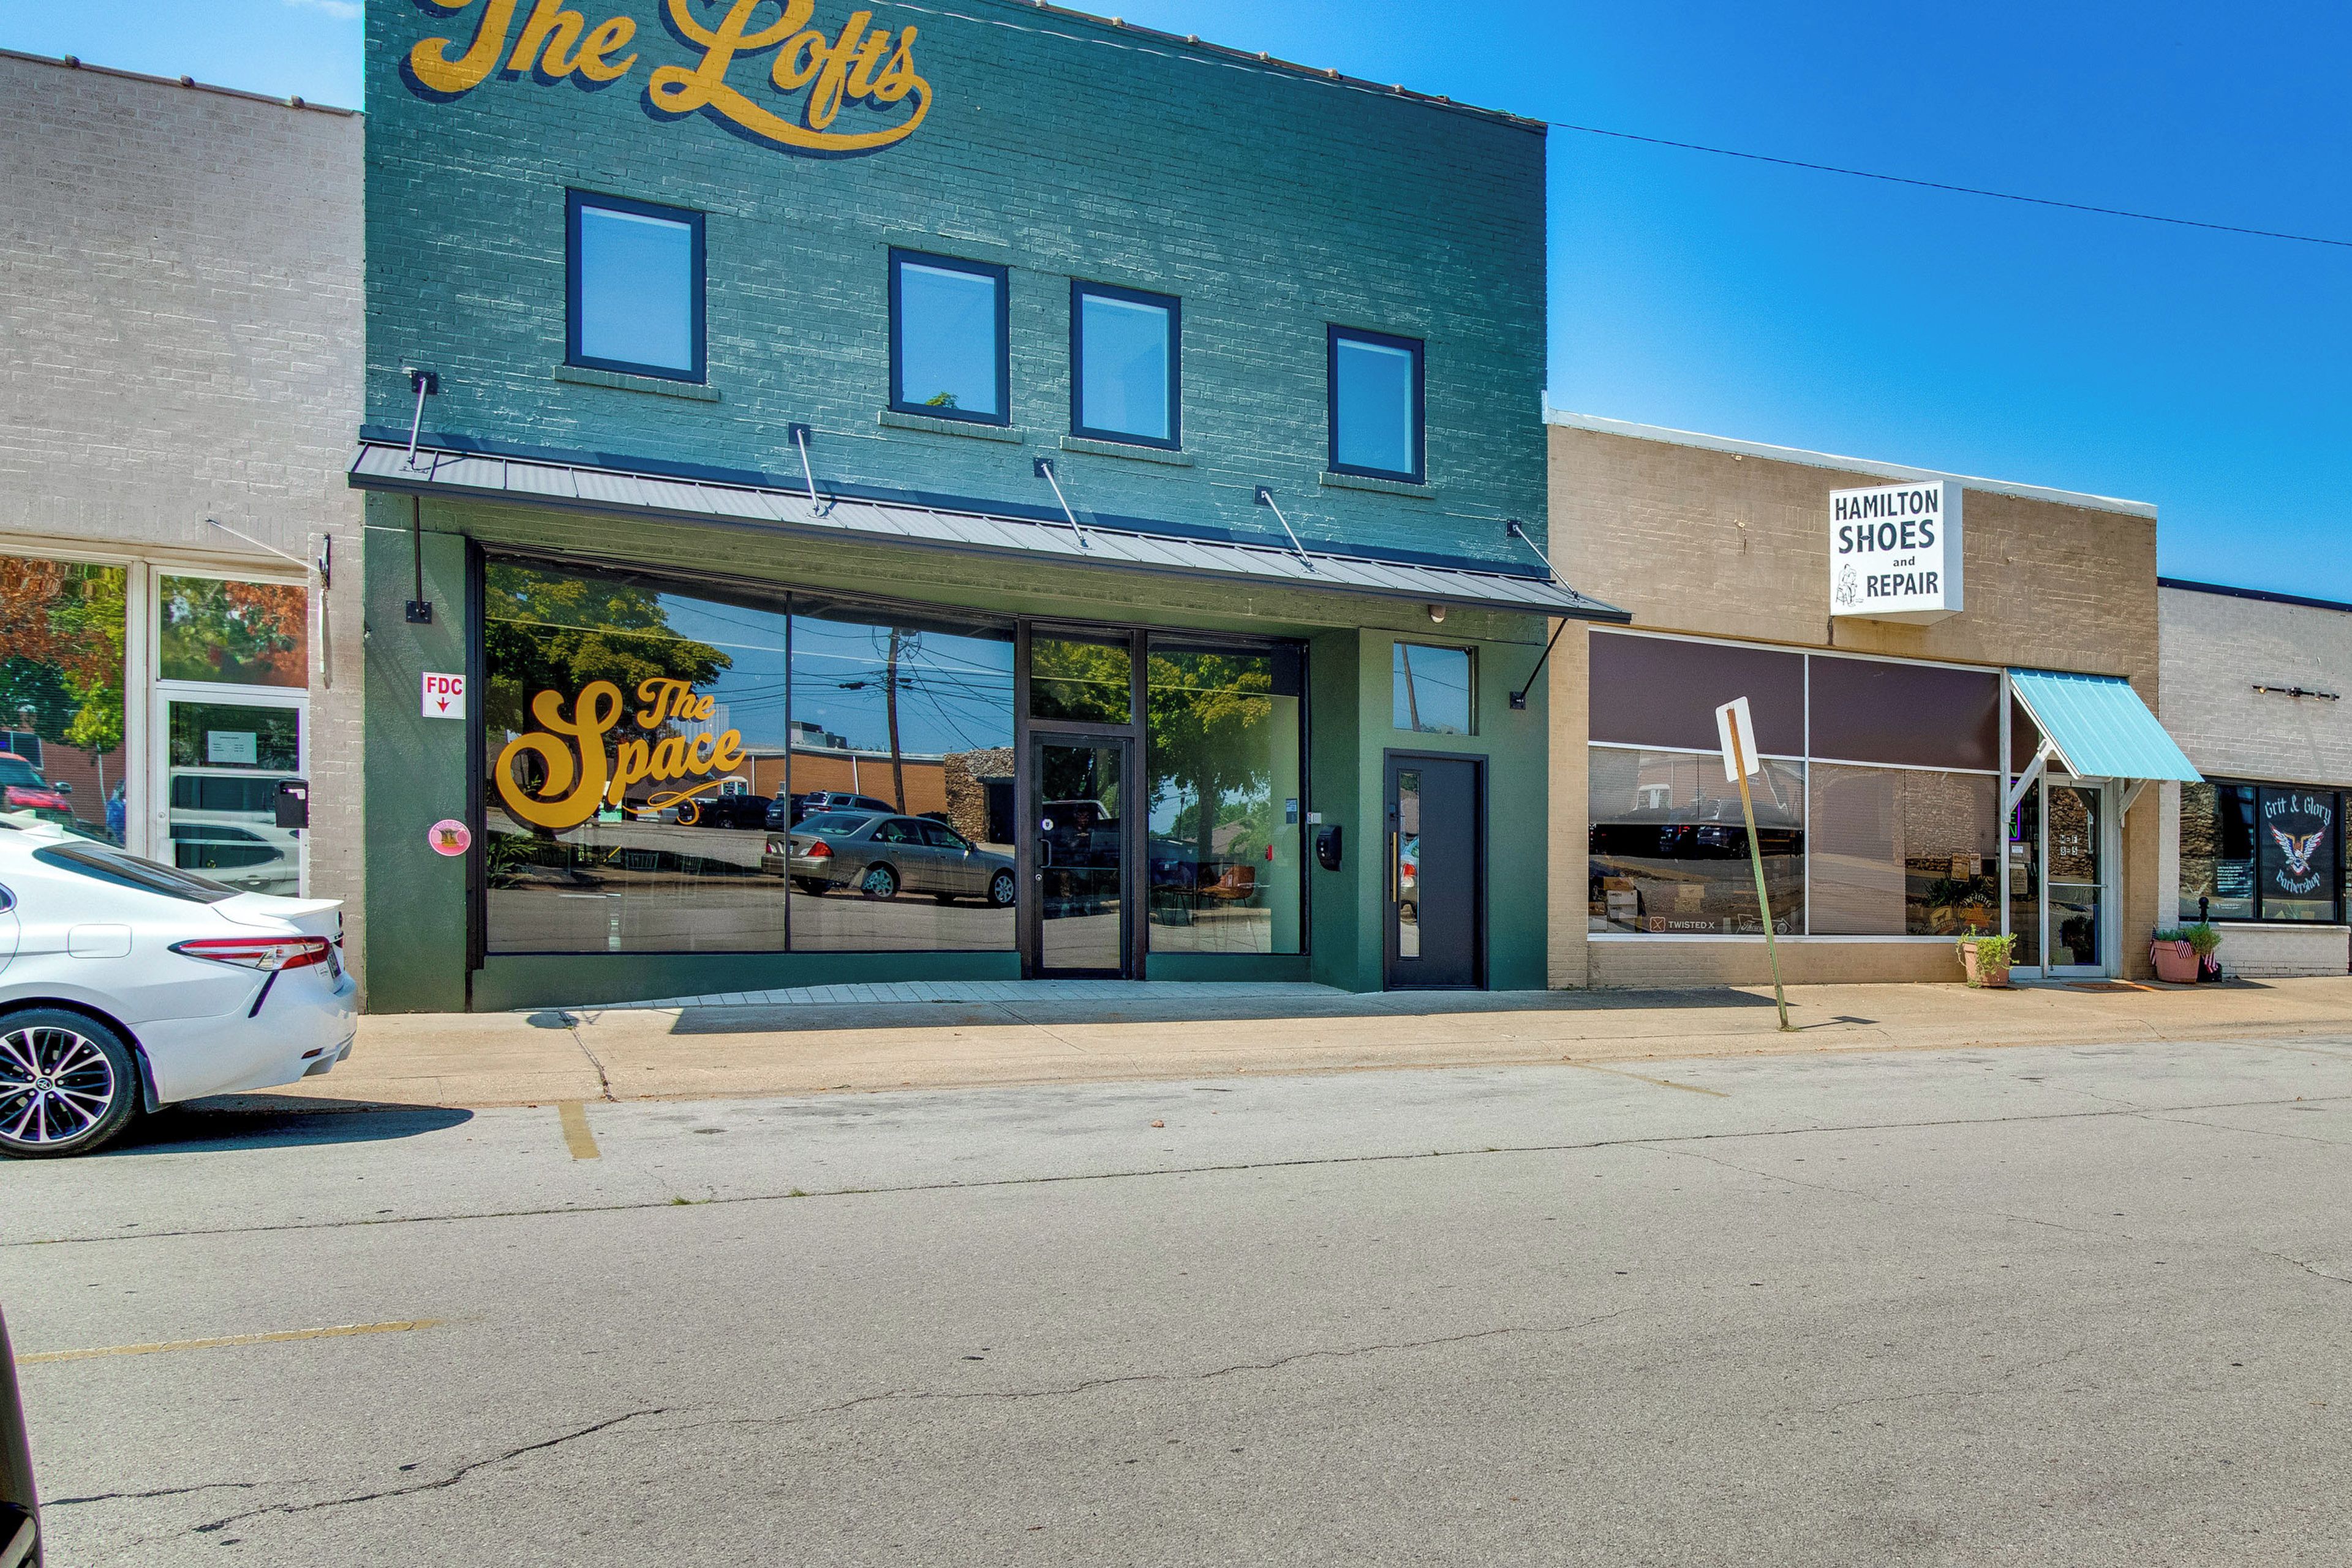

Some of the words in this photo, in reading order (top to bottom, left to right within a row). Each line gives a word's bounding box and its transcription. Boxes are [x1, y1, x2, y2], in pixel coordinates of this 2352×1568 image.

[405, 0, 638, 98] The
[647, 0, 932, 153] Lofts
[1836, 489, 1938, 521] HAMILTON
[1839, 519, 1935, 554] SHOES
[1893, 556, 1915, 567] and
[1867, 571, 1939, 598] REPAIR
[427, 676, 463, 696] FDC
[636, 677, 716, 729] The
[495, 680, 747, 829] Space
[2264, 797, 2287, 819] Grit
[2290, 794, 2299, 813] &
[2304, 796, 2332, 826] Glory
[2276, 869, 2320, 894] Barbershop
